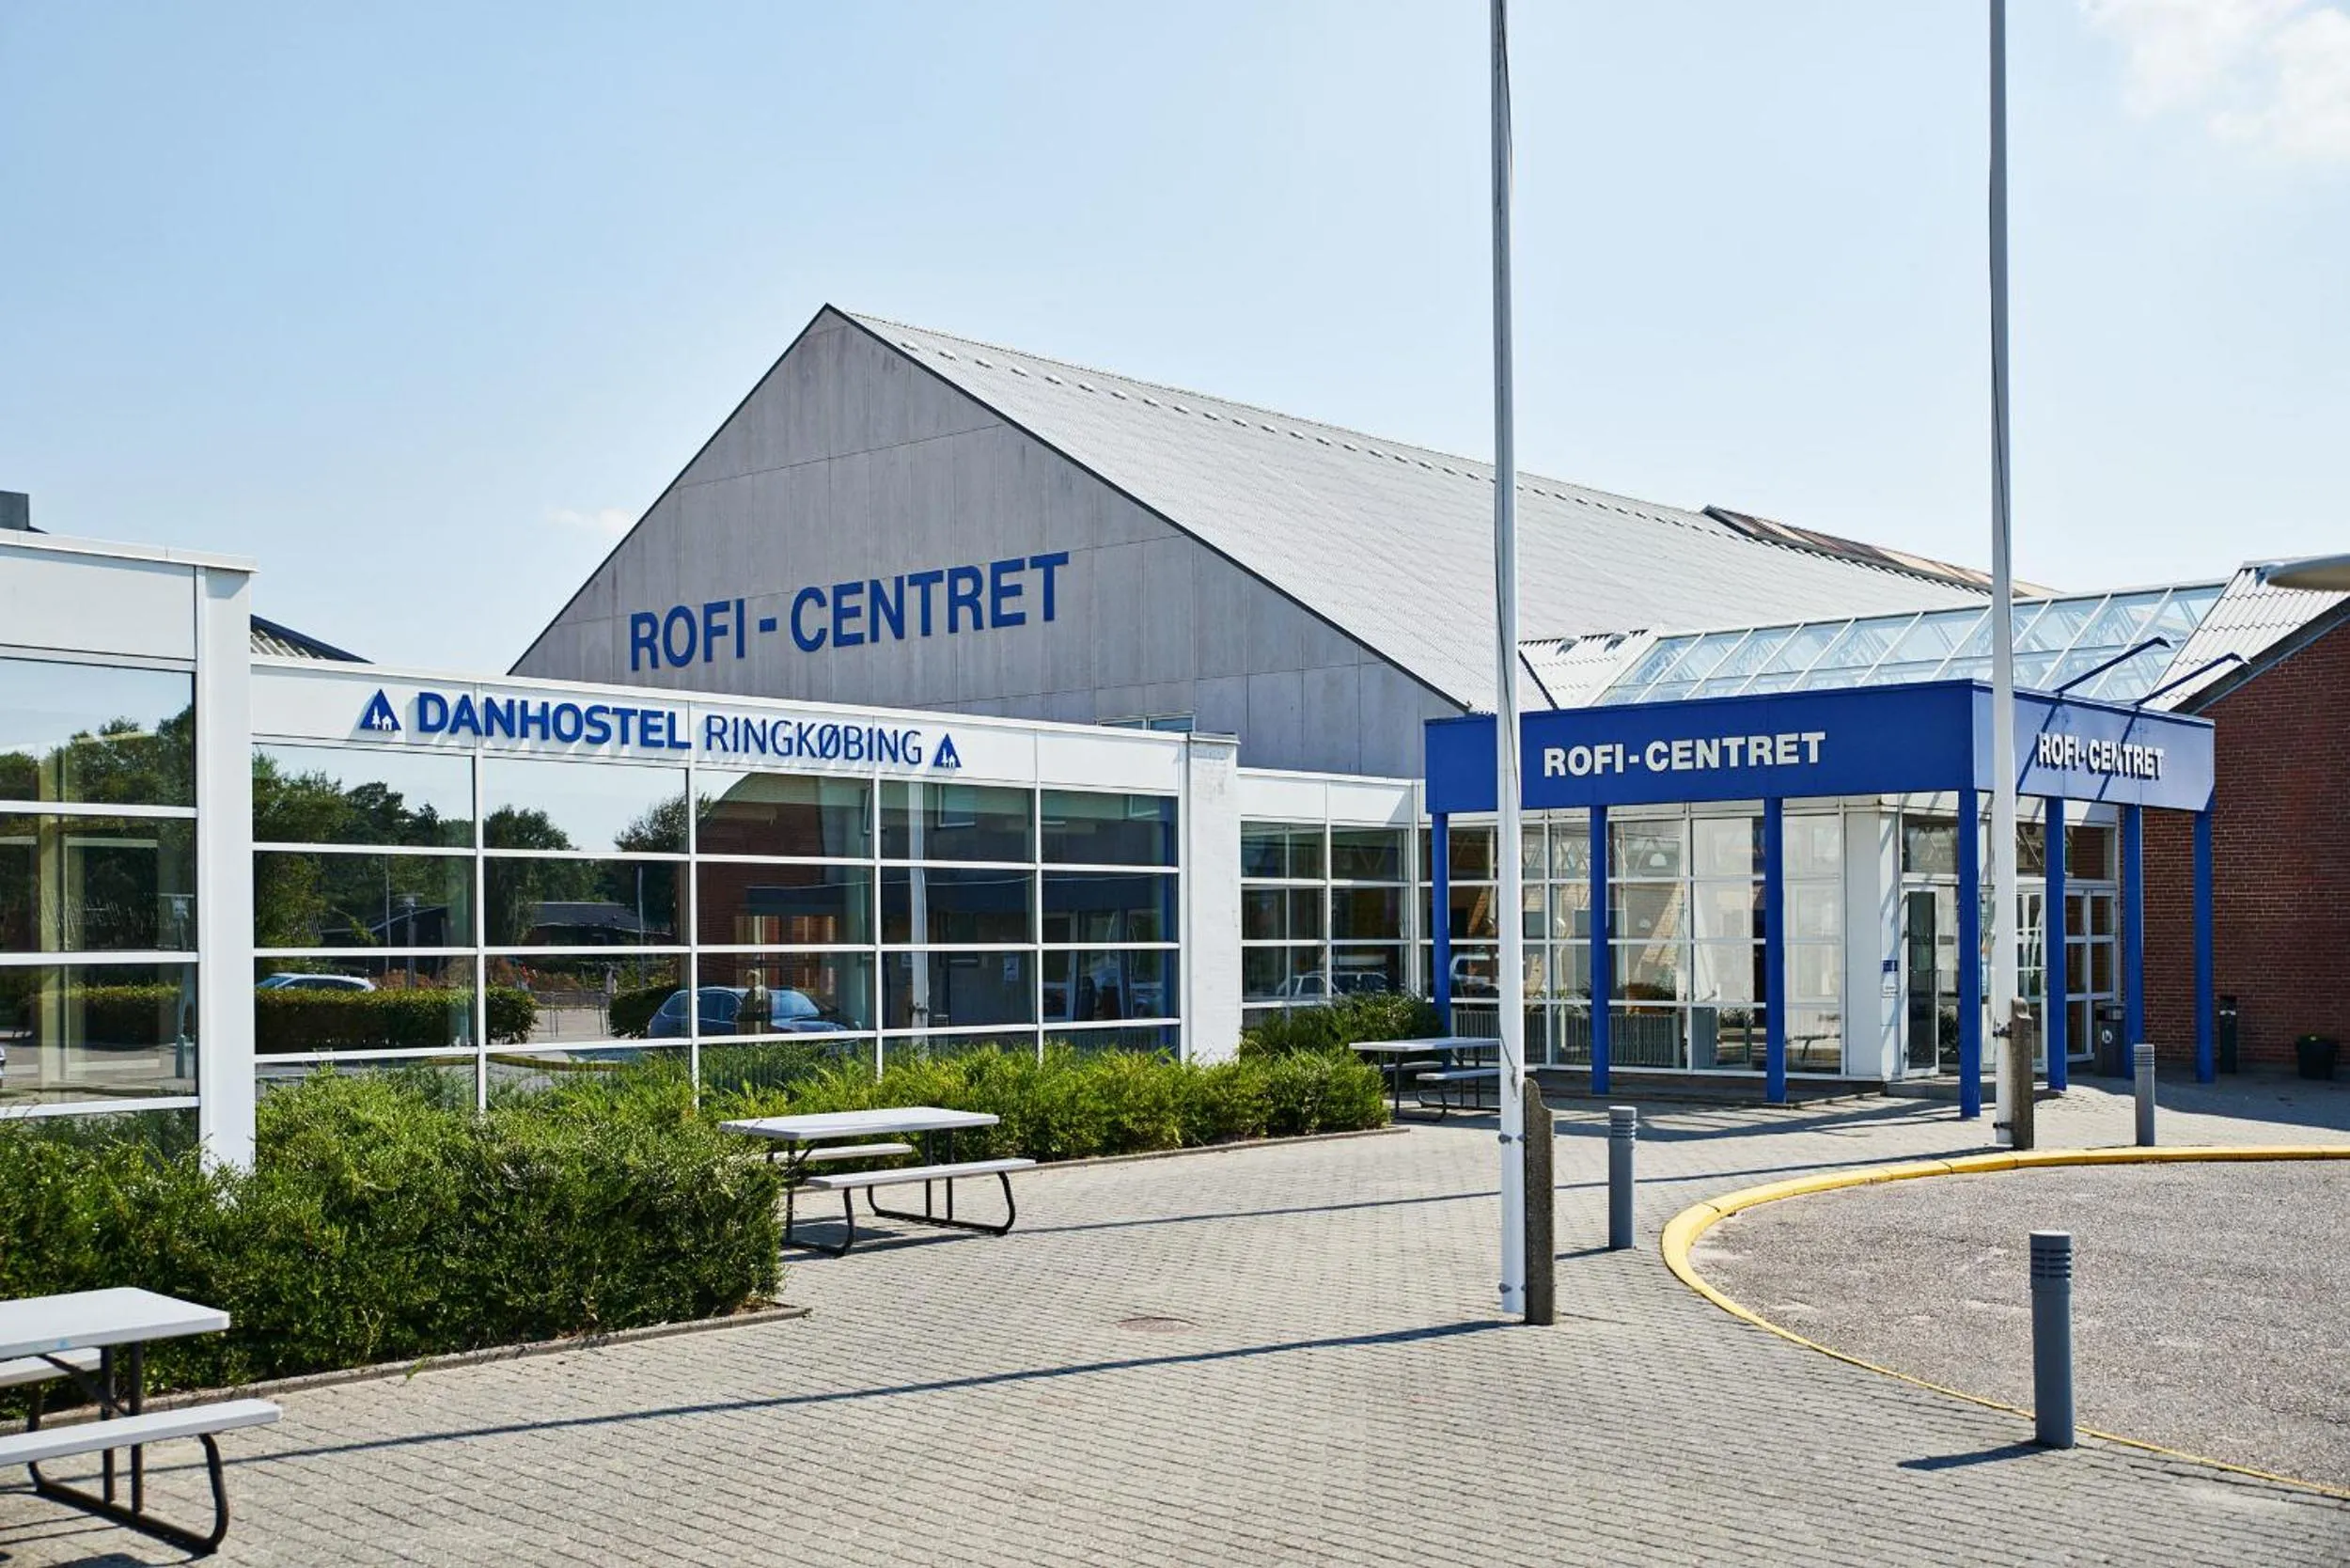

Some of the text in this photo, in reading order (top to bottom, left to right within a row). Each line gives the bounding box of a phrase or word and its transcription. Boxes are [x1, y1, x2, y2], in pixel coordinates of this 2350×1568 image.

[418, 692, 921, 765] DANHOSTEL RINGKØBING
[1544, 732, 1825, 777] ROFI-CENTRET
[2037, 732, 2164, 778] ROFI-CENTRET
